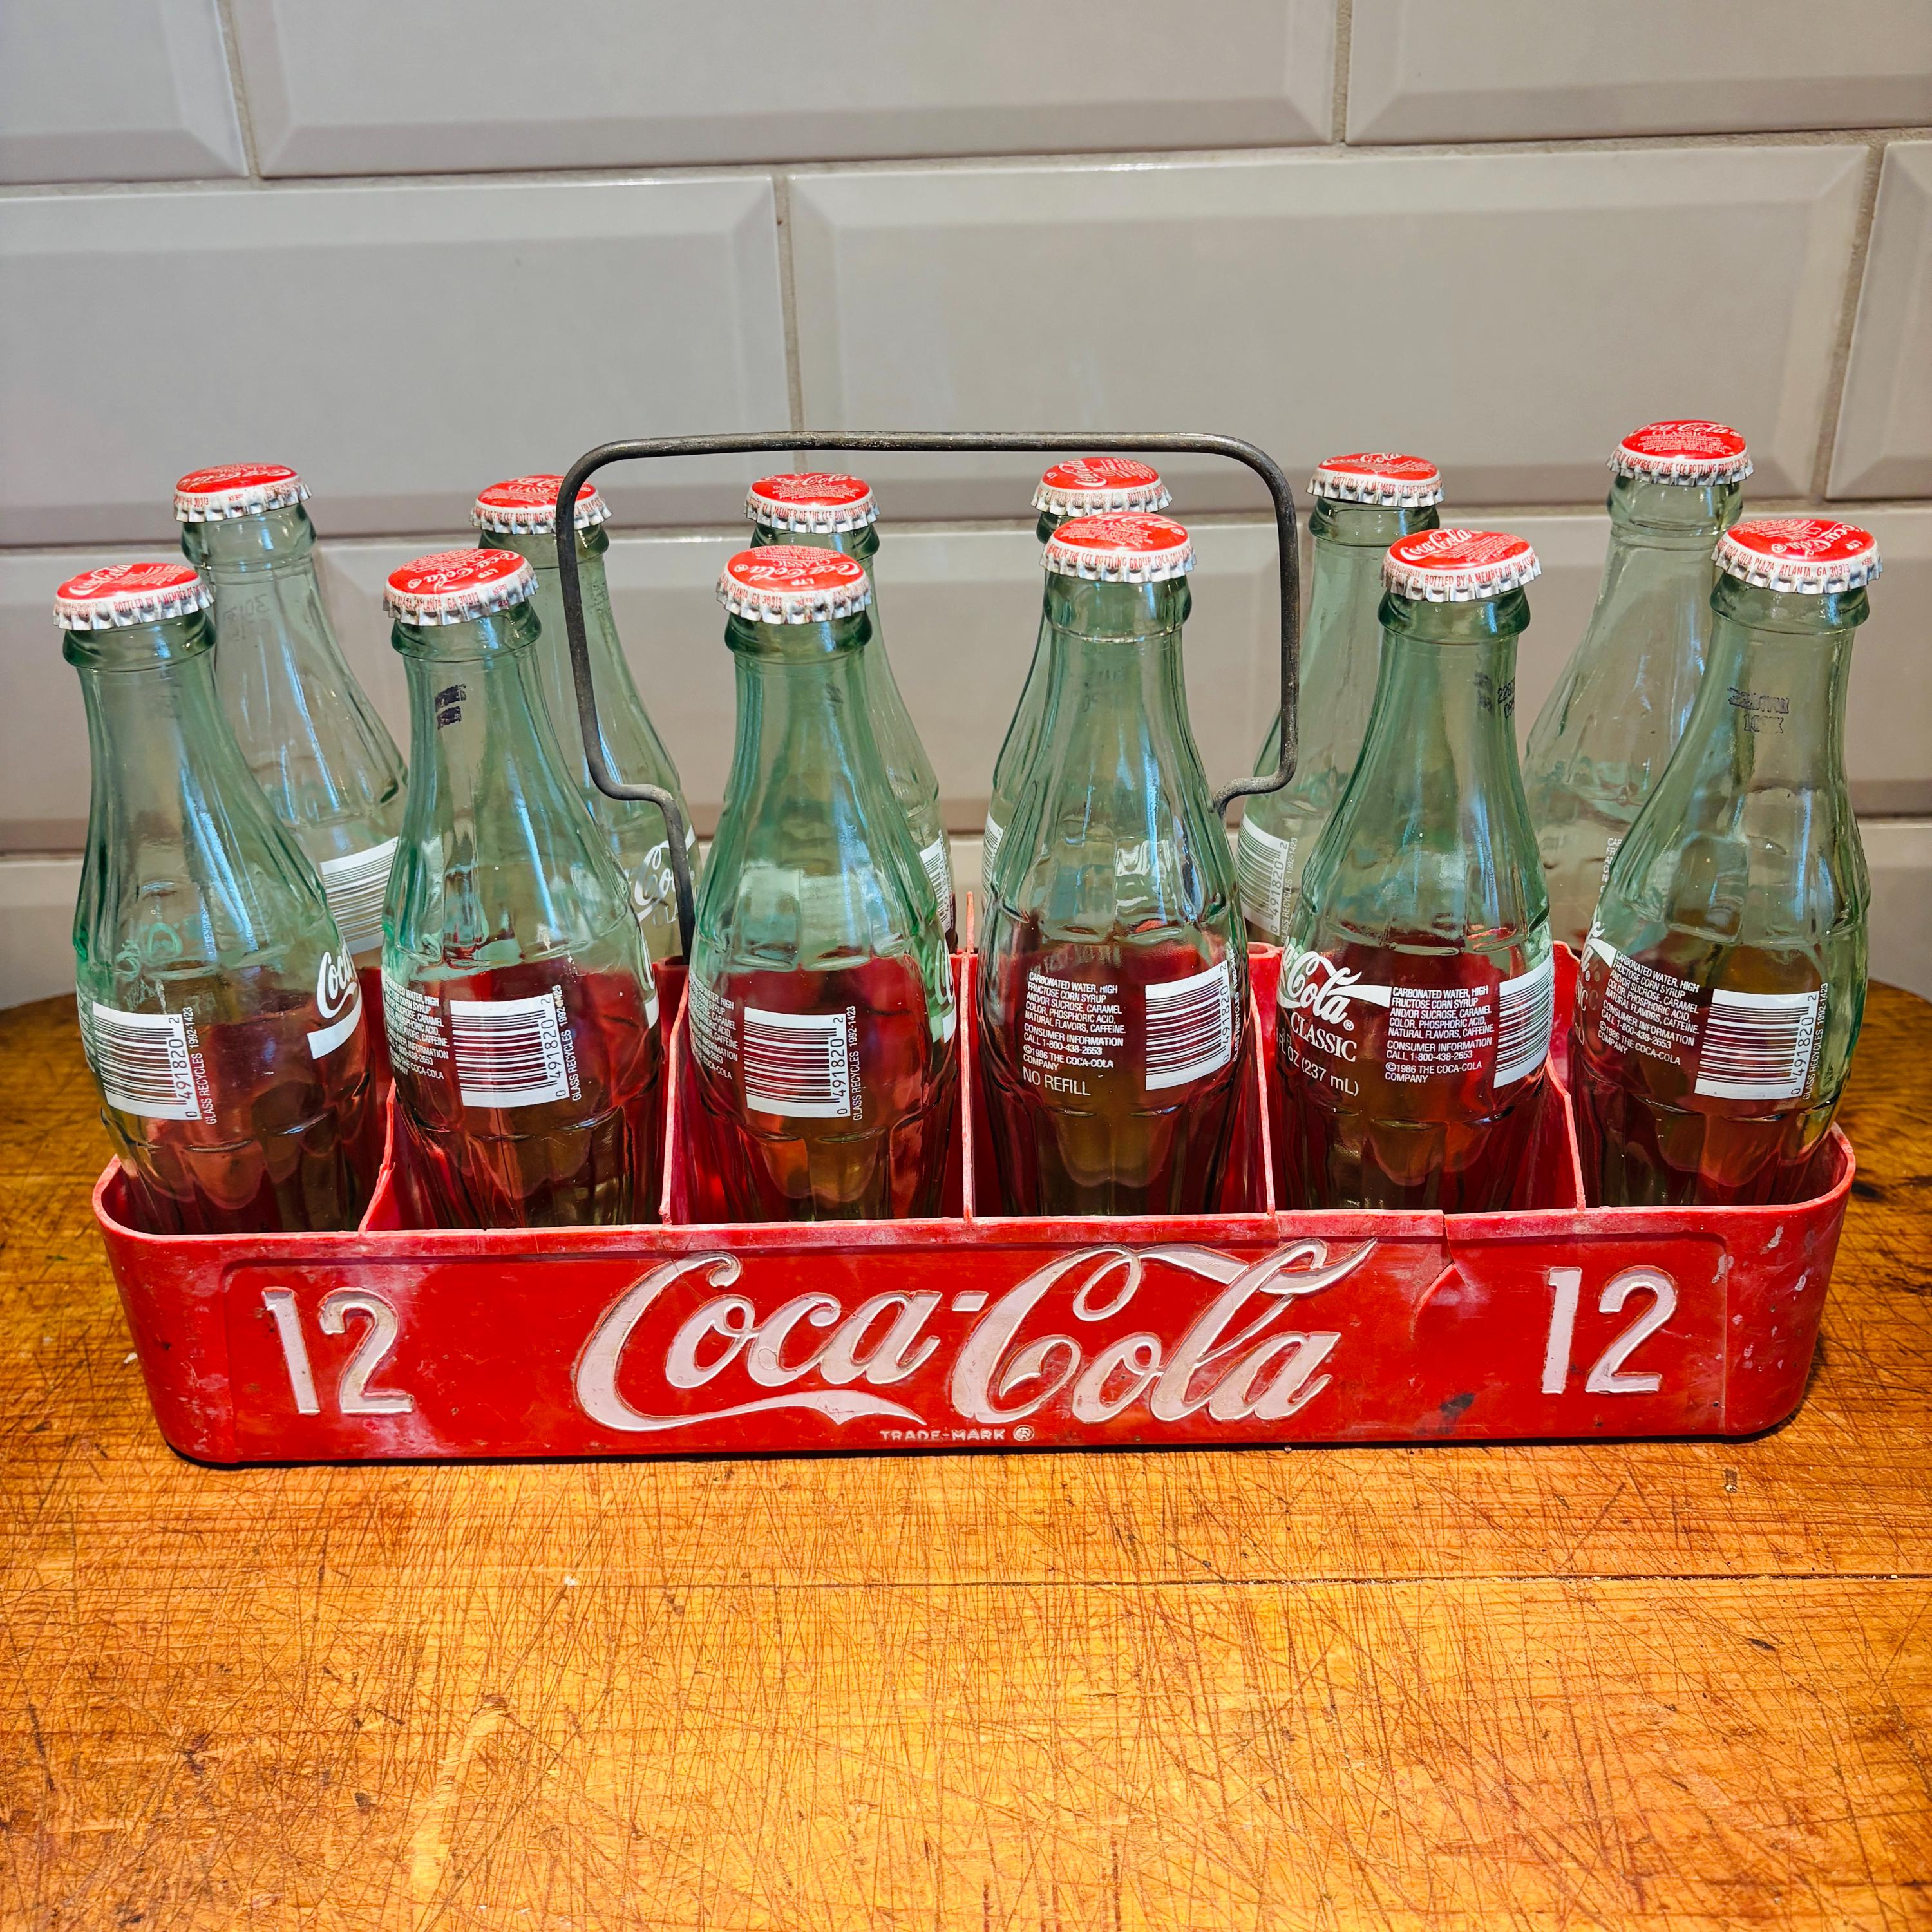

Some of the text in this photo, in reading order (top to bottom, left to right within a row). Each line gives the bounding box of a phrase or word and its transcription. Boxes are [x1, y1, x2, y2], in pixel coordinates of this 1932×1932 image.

[1652, 461, 1660, 469] OF
[1661, 462, 1673, 475] THE
[1689, 463, 1716, 475] BOTTLING
[1371, 481, 1395, 494] MEMBER
[809, 511, 819, 521] THE
[1095, 556, 1127, 567] BOTTLING
[1130, 556, 1151, 570] GROUP
[1779, 564, 1850, 579] ATLANTA, GA 30313
[1425, 565, 1511, 587] BOTTLED BY A MEMBER OF
[113, 600, 143, 612] BOTTLED
[459, 592, 479, 607] 30313
[1269, 862, 1284, 916] 491820
[1282, 879, 1293, 916] RECYCLES
[1029, 972, 1117, 994] CARBONATED WATER, HIGH
[1613, 960, 1685, 999] FRUCTOSE CORN SYRUP
[1616, 951, 1700, 993] CARBONATED HIGH
[1027, 992, 1122, 1014] AND/OR SUCROSE, CARAMEL
[1028, 982, 1106, 1003] FRUCTOSE CORN SYRUP
[1392, 998, 1478, 1009] FRUCTOSE CORN SYRUP
[1393, 985, 1488, 999] CARBONATED WATER, HIGH
[1026, 1001, 1116, 1024] COLOR, PHOSPHORIC ACID,
[1220, 985, 1230, 1044] 491820
[1390, 1008, 1419, 1018] AND/OR
[1459, 1005, 1492, 1018] CARAMEL
[1605, 987, 1629, 1010] NATURAL
[1631, 1003, 1662, 1025] FLAVORS,
[1627, 990, 1669, 1016] PHOSPHORIC
[1671, 1009, 1690, 1023] ACID,
[1663, 996, 1698, 1014] CARAMEL
[417, 1014, 444, 1027] CARAMEL
[1025, 1010, 1054, 1027] NATURAL
[1055, 1019, 1088, 1033] FLAVORS,
[1390, 1016, 1486, 1029] COLOR, PHOSPHORIC ACID,
[1601, 1009, 1671, 1050] CALL 1-800-438-2653
[1603, 999, 1694, 1046] CONSUMER INFORMATION
[1024, 1032, 1102, 1055] CALL 1-800-438-2653
[1025, 1023, 1123, 1046] CONSUMER INFORMATION
[1291, 1012, 1357, 1062] CLASSIC
[1387, 1037, 1492, 1052] CONSUMER INFORMATION
[1388, 1027, 1461, 1039] NATURAL FLAVORS,
[1598, 1030, 1628, 1054] COMPANY
[1803, 983, 1828, 1100] GLASS RECYCLES 1992-1423
[541, 1019, 563, 1078] 491820
[1387, 1050, 1473, 1061] CALL 1-800-438-2653
[1621, 1035, 1681, 1065] THE COCA-COLA
[1792, 1017, 1814, 1076] 491820
[169, 1039, 193, 1099] 491820
[183, 1007, 217, 1125] GLASS RECYCLES 1992-1423
[411, 1063, 444, 1079] COCA-COLA
[561, 1030, 582, 1101] GLASS RECYCLES
[831, 1039, 846, 1097] 491820
[846, 1006, 862, 1121] GLASS RECYCLES 1992-1423
[1023, 1054, 1059, 1070] COMPANY
[1050, 1052, 1065, 1063] THE
[1066, 1056, 1113, 1068] COCA-COLA
[1418, 1065, 1434, 1074] THE
[1437, 1061, 1482, 1073] COCA-COLA
[1023, 1066, 1090, 1095] NO REFILL
[1302, 1057, 1327, 1081] (237
[1331, 1075, 1359, 1096] mL)
[1385, 1072, 1428, 1083] COMPANY
[574, 1238, 1378, 1432] Coca-Cola
[1542, 1264, 1678, 1394] 12
[261, 1287, 415, 1416] 12
[880, 1428, 1006, 1441] TRADE-MARK
